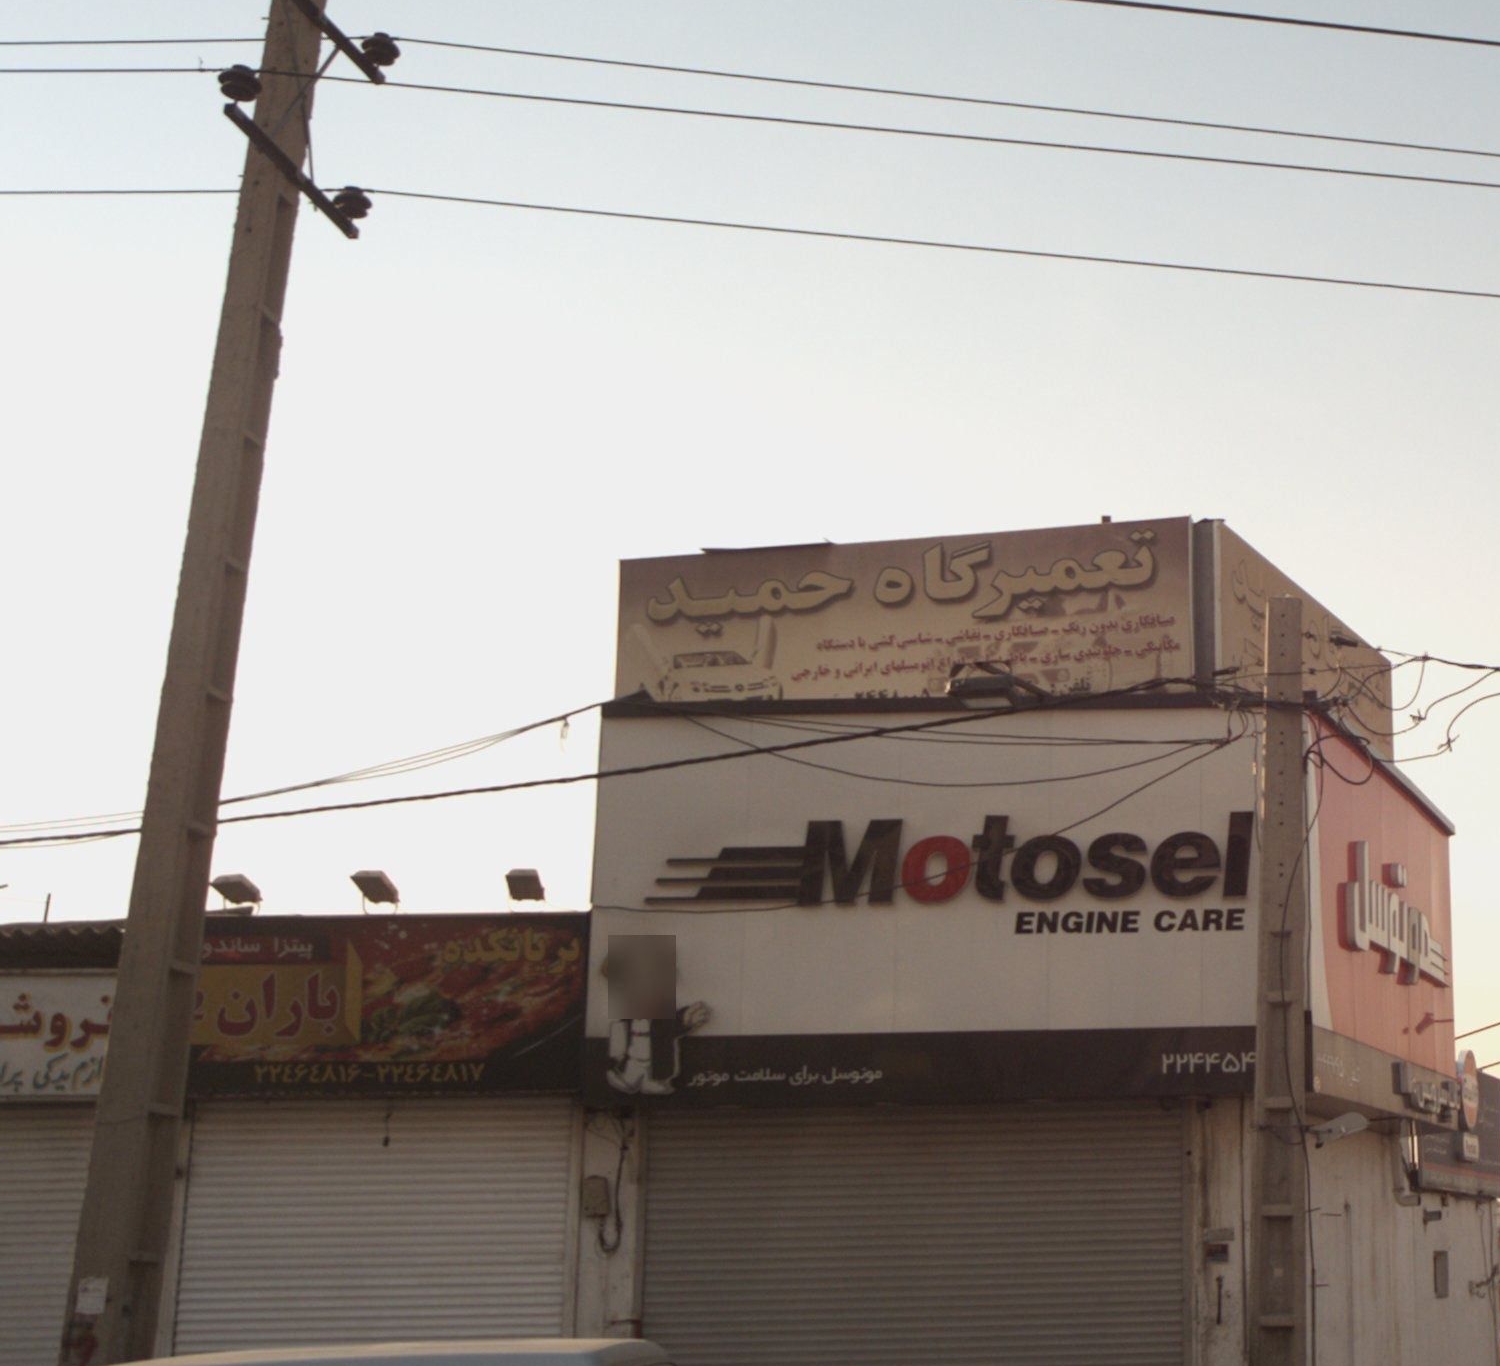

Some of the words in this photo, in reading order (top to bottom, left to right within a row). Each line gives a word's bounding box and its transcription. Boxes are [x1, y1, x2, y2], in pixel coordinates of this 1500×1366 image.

[873, 529, 1157, 619] تعمیرگاه
[646, 571, 854, 635] حمید
[994, 624, 1049, 642] صافکاری
[1089, 619, 1119, 636] بدون
[790, 663, 831, 682] خارجی
[842, 660, 878, 678] ایرانی
[797, 811, 1255, 906] Motosel
[1014, 910, 1141, 935] ENGINE
[1153, 907, 1246, 933] CARE
[201, 936, 261, 960] ساندو
[273, 936, 314, 961] پیتزا
[215, 970, 339, 1037] باران
[1161, 1051, 1257, 1074] ۲۲۴۴۵۴
[687, 1068, 730, 1087] موتور
[733, 1066, 787, 1083] سلامت
[788, 1064, 820, 1086] برای
[820, 1067, 884, 1086] موتوسل
